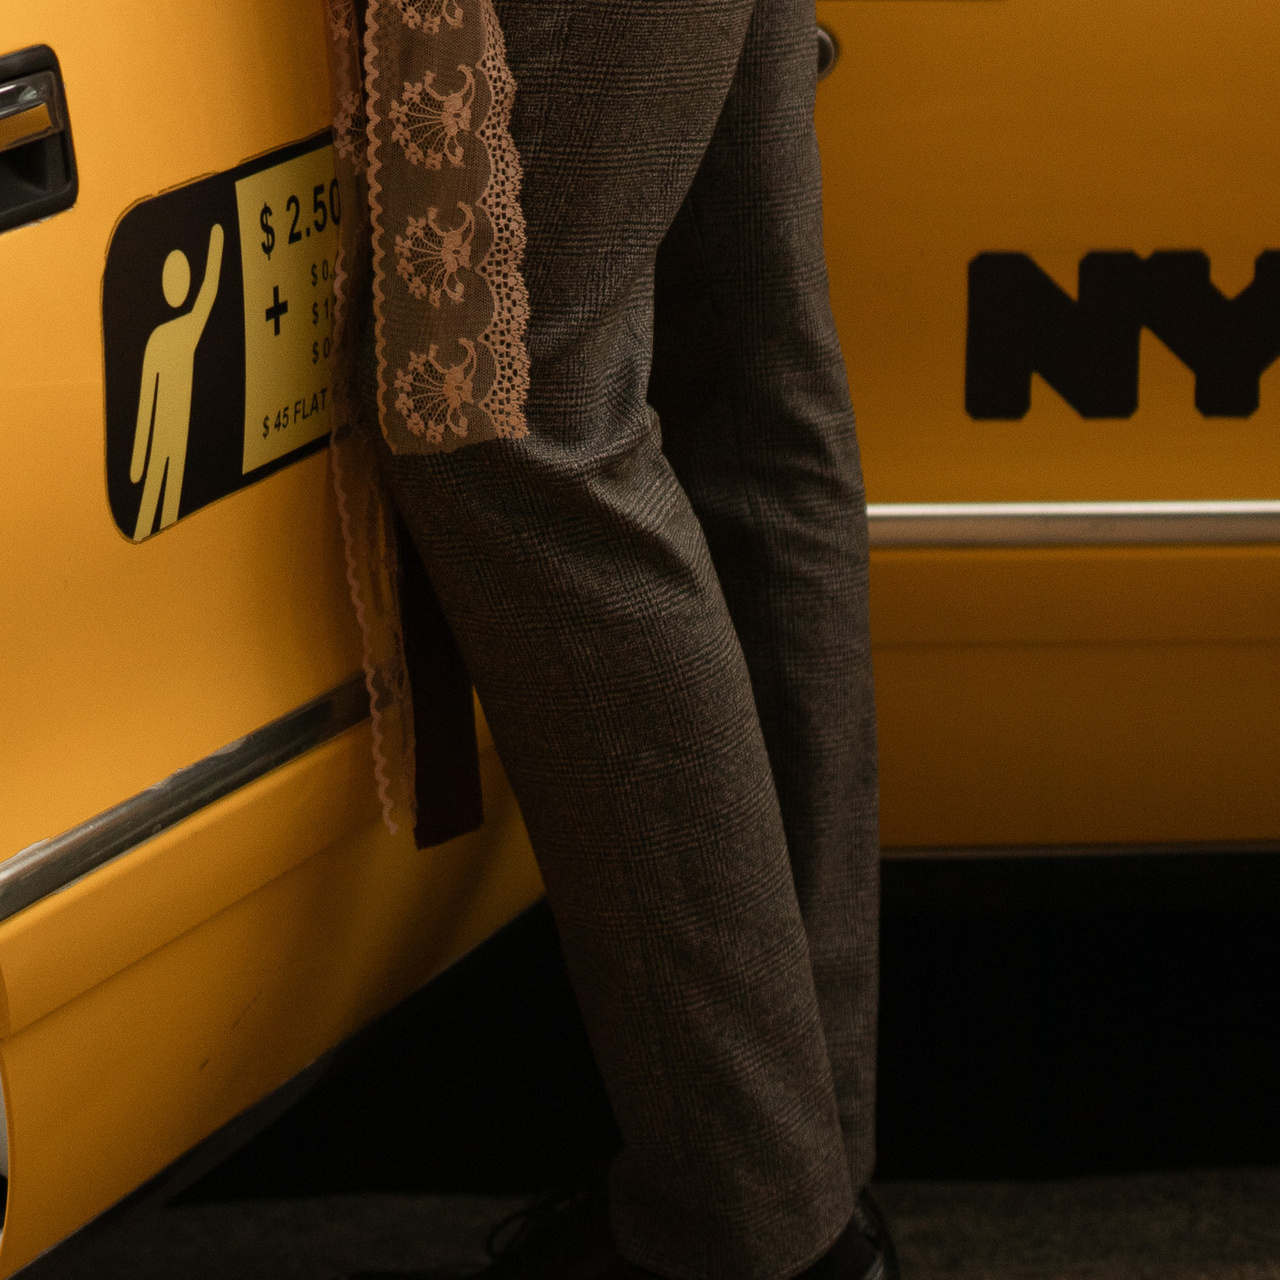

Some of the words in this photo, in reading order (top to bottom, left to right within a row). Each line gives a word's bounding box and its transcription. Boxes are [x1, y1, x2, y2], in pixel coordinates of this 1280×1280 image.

[286, 178, 341, 245] 2.50
[274, 406, 289, 431] 45
[294, 387, 328, 424] FLAT
